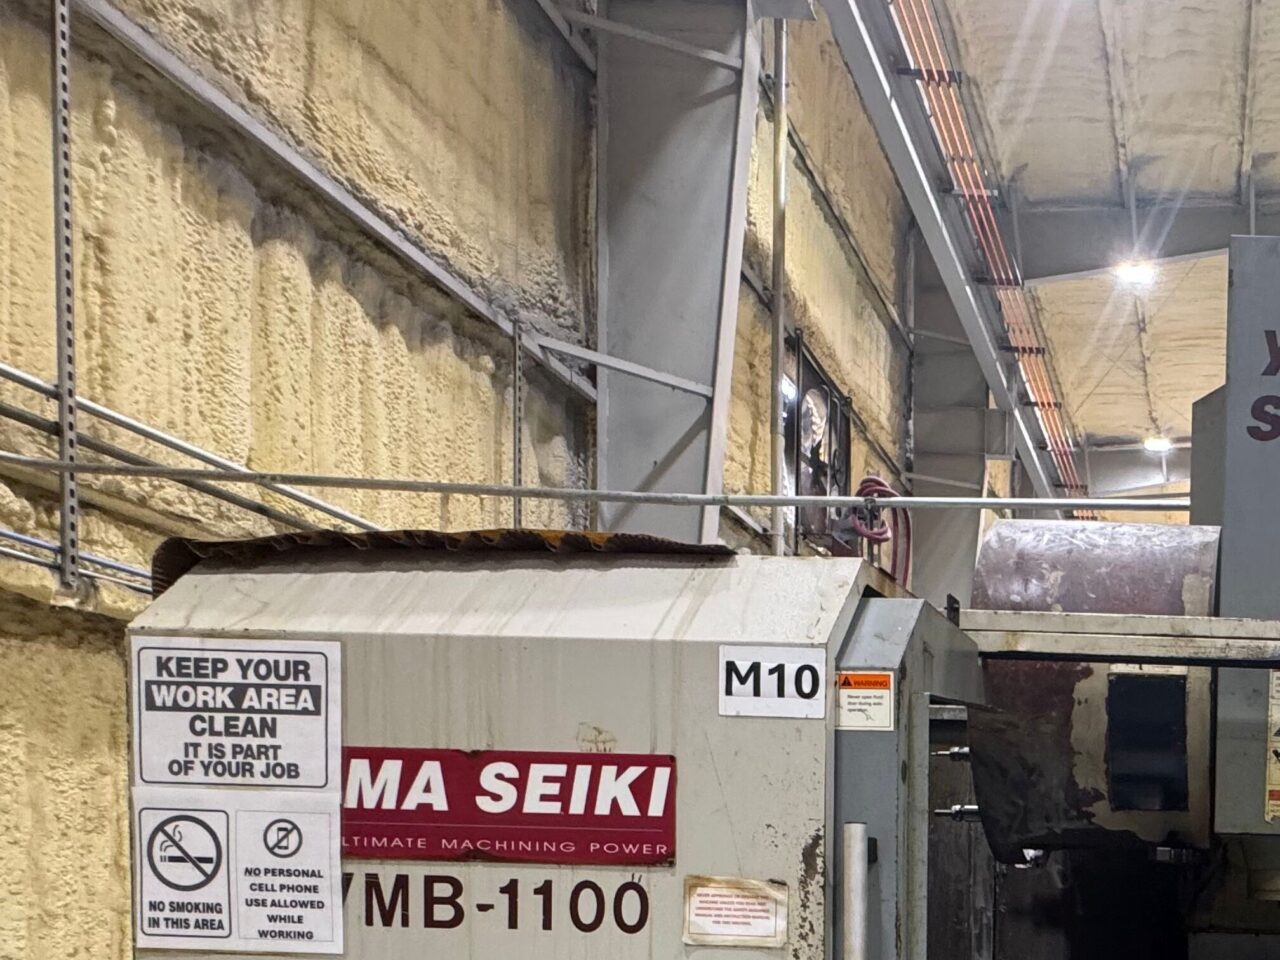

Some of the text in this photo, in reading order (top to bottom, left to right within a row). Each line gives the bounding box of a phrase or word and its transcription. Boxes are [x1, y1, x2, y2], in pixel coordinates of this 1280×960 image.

[156, 656, 311, 682] KEEP YOUR
[725, 660, 820, 700] M10
[151, 684, 316, 711] WORK AREA
[189, 714, 277, 738] CLEAN
[184, 742, 281, 760] IT IS PART
[168, 759, 300, 779] OF YOUR JOB
[475, 761, 672, 817] SEIKI
[441, 839, 576, 853] MACHINING
[590, 841, 668, 855] POWER
[244, 867, 324, 878] NO PERSONAL
[250, 883, 319, 893] CELL PHONE
[148, 901, 223, 914] NO SMOKING
[245, 899, 325, 909] USE ALLOWED
[148, 917, 225, 931] IN THIS AREA
[267, 914, 304, 924] WHILE
[257, 929, 314, 940] WORKING
